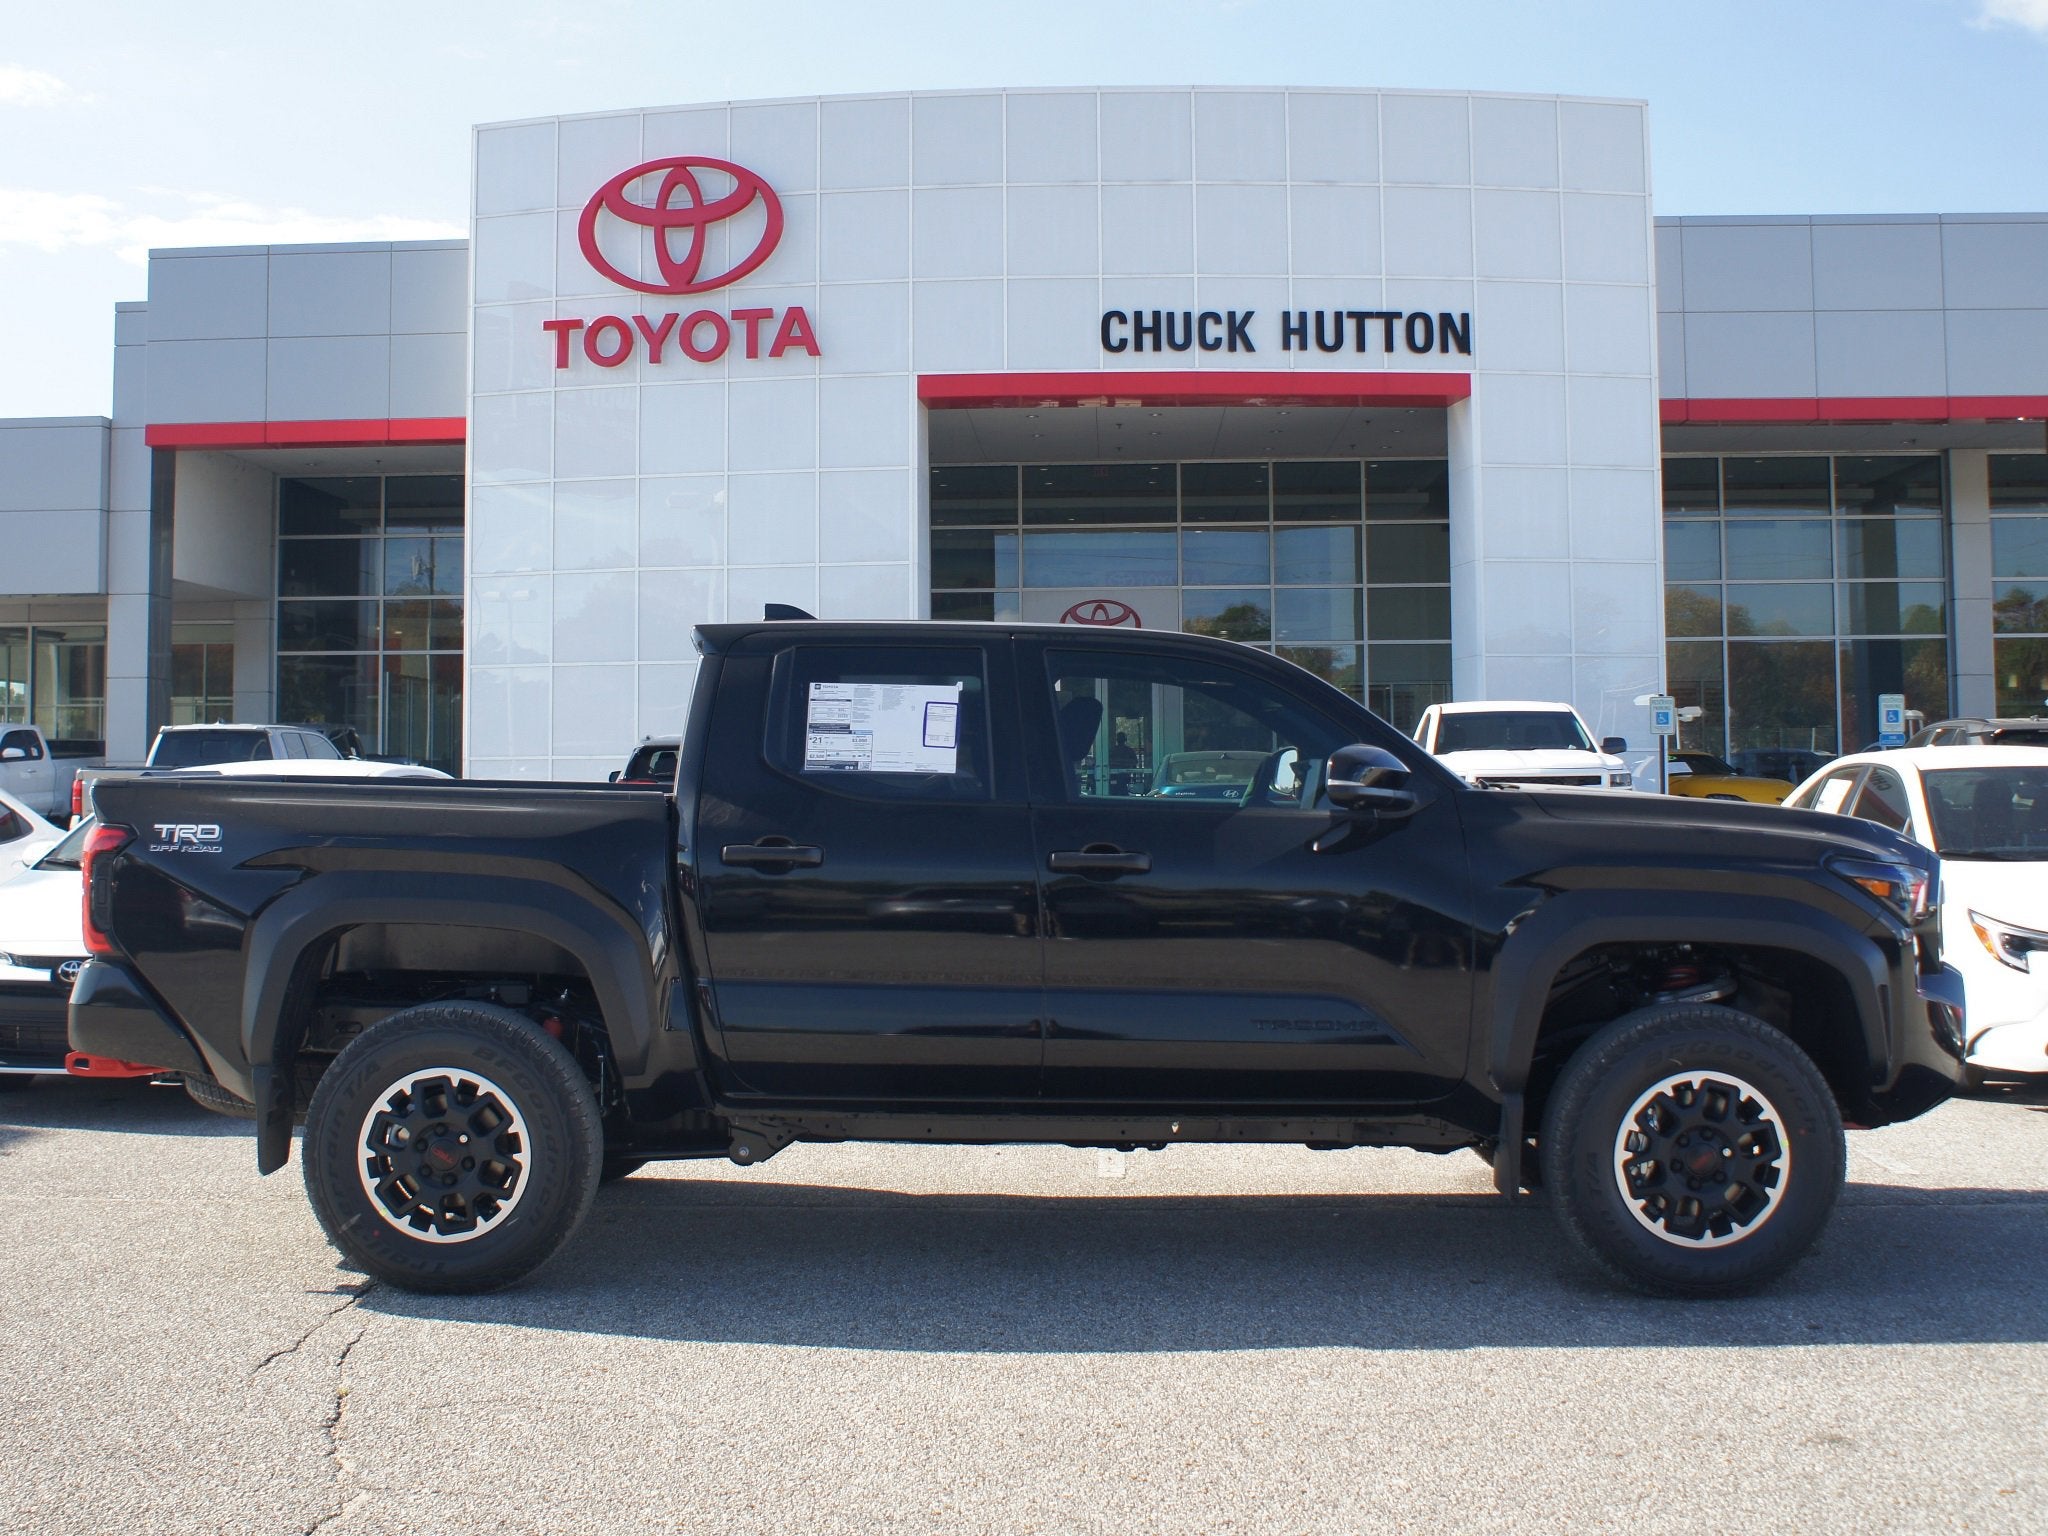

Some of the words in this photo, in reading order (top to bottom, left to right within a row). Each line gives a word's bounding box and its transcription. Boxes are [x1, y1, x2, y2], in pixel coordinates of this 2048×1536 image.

[543, 306, 821, 369] TOYOTA
[1100, 310, 1256, 353] CHUCK
[1282, 311, 1471, 356] HUTTON
[149, 844, 180, 852] OFF
[181, 845, 223, 853] ROAD
[153, 823, 222, 843] TRD
